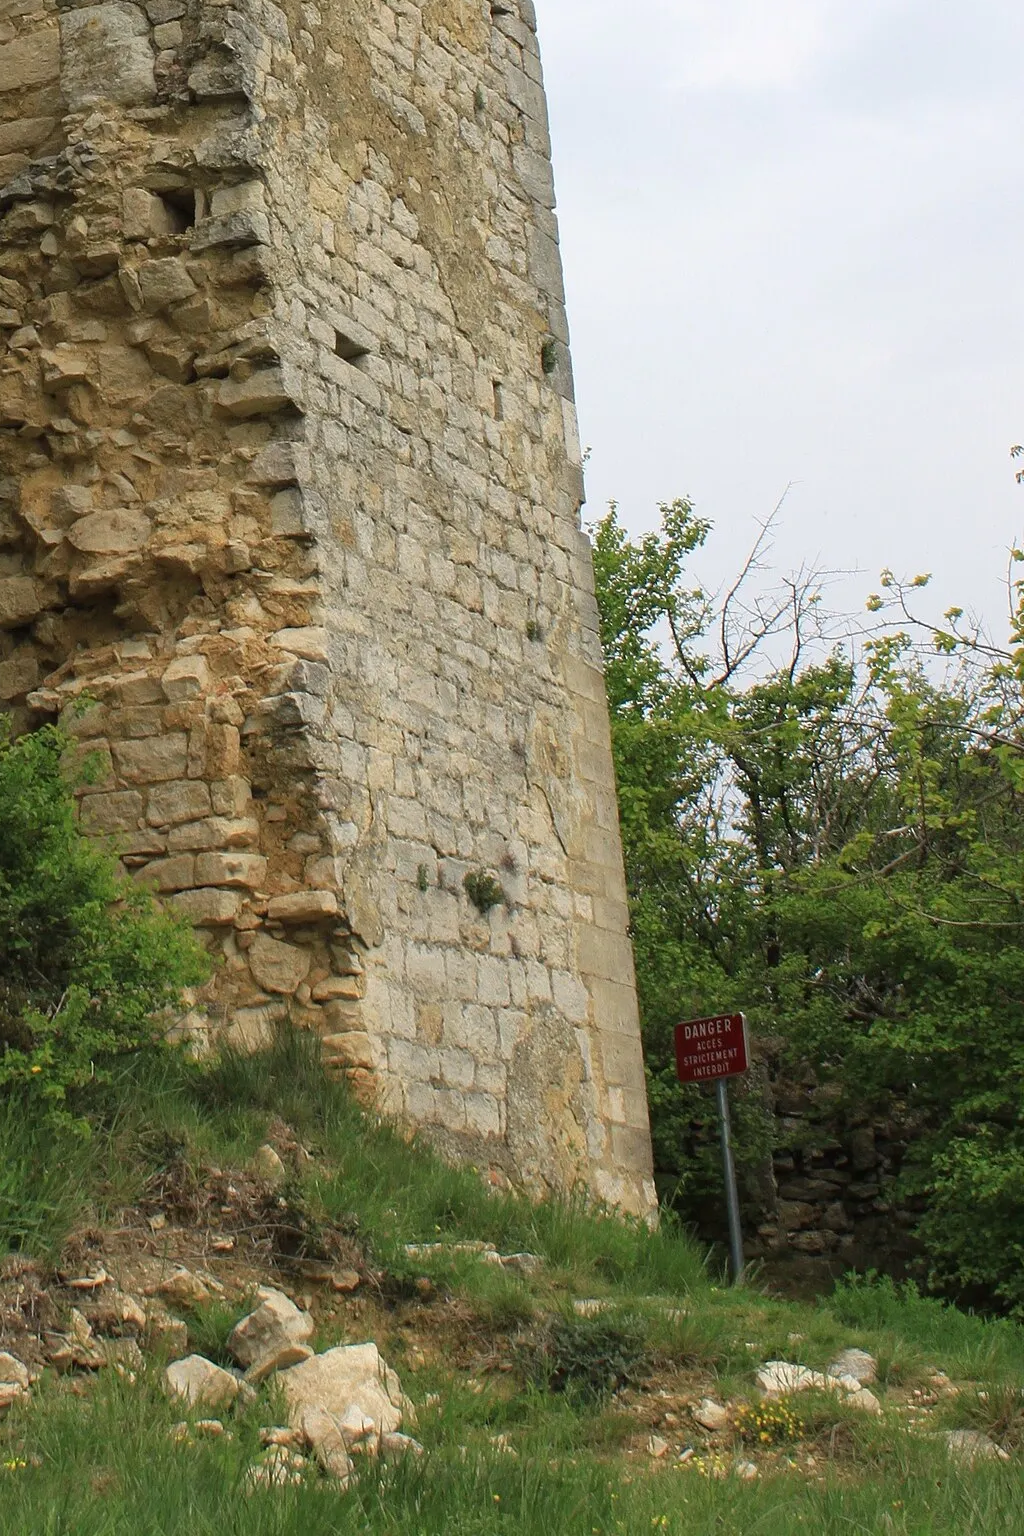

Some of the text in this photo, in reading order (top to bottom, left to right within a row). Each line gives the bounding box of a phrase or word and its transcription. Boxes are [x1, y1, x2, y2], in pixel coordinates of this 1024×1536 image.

[684, 1019, 732, 1039] DANGER
[683, 1048, 738, 1066] STRICTEMENT
[693, 1062, 730, 1076] INTERDIT
